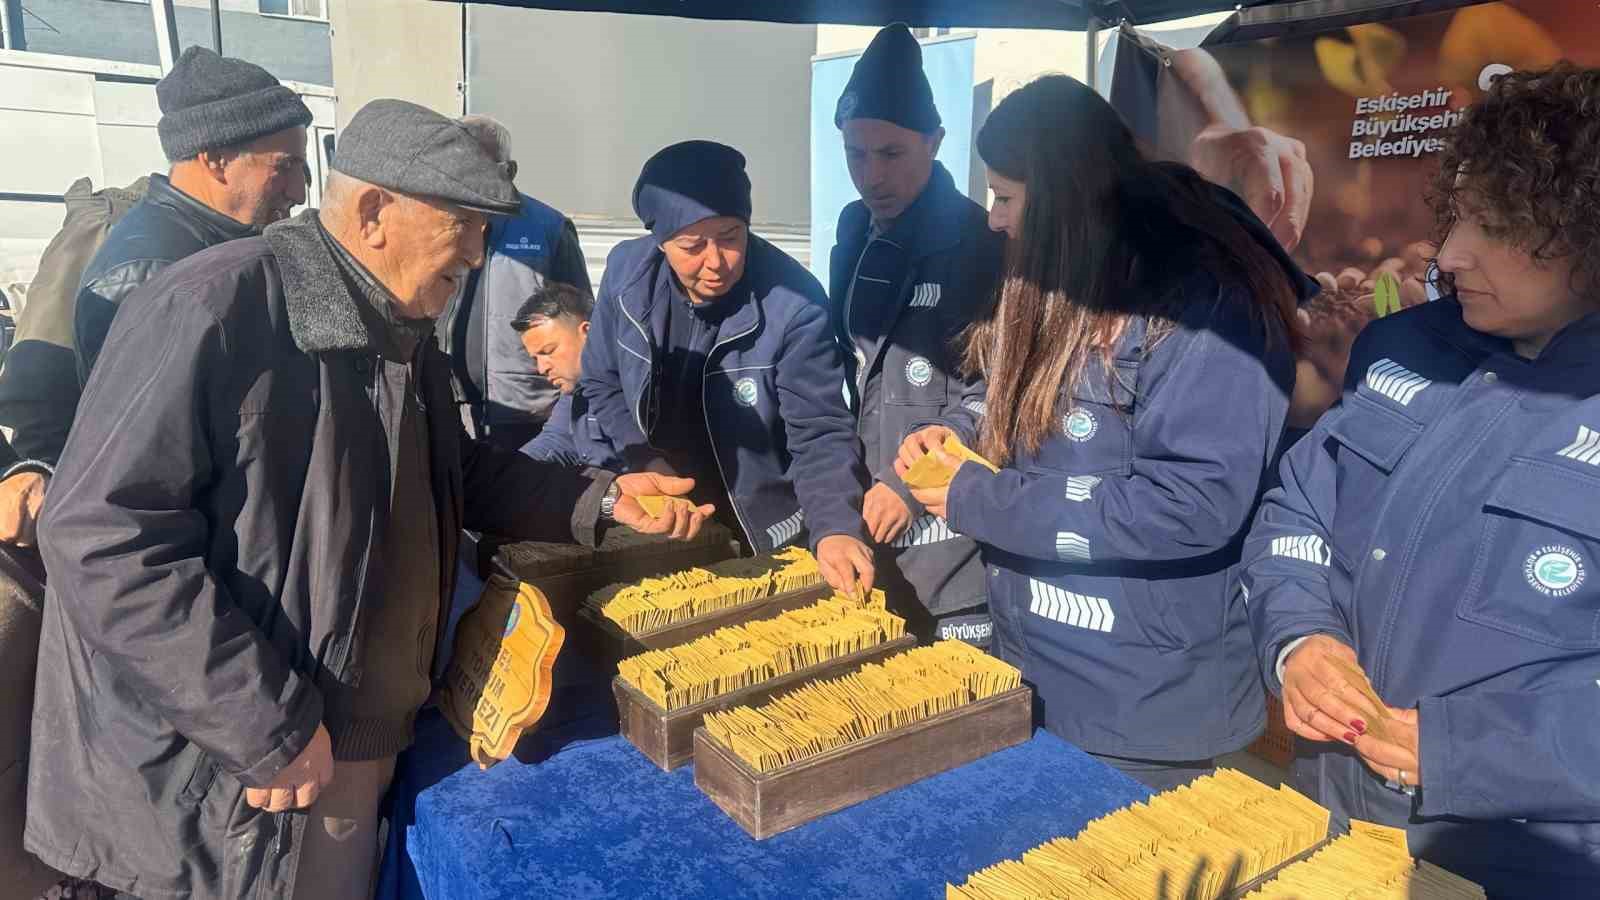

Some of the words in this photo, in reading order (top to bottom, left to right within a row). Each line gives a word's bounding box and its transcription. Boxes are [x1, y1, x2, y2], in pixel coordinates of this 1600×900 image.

[1355, 86, 1453, 115] Eskişehir
[1351, 107, 1465, 138] Büyükşehi
[1349, 136, 1447, 159] Belediyes
